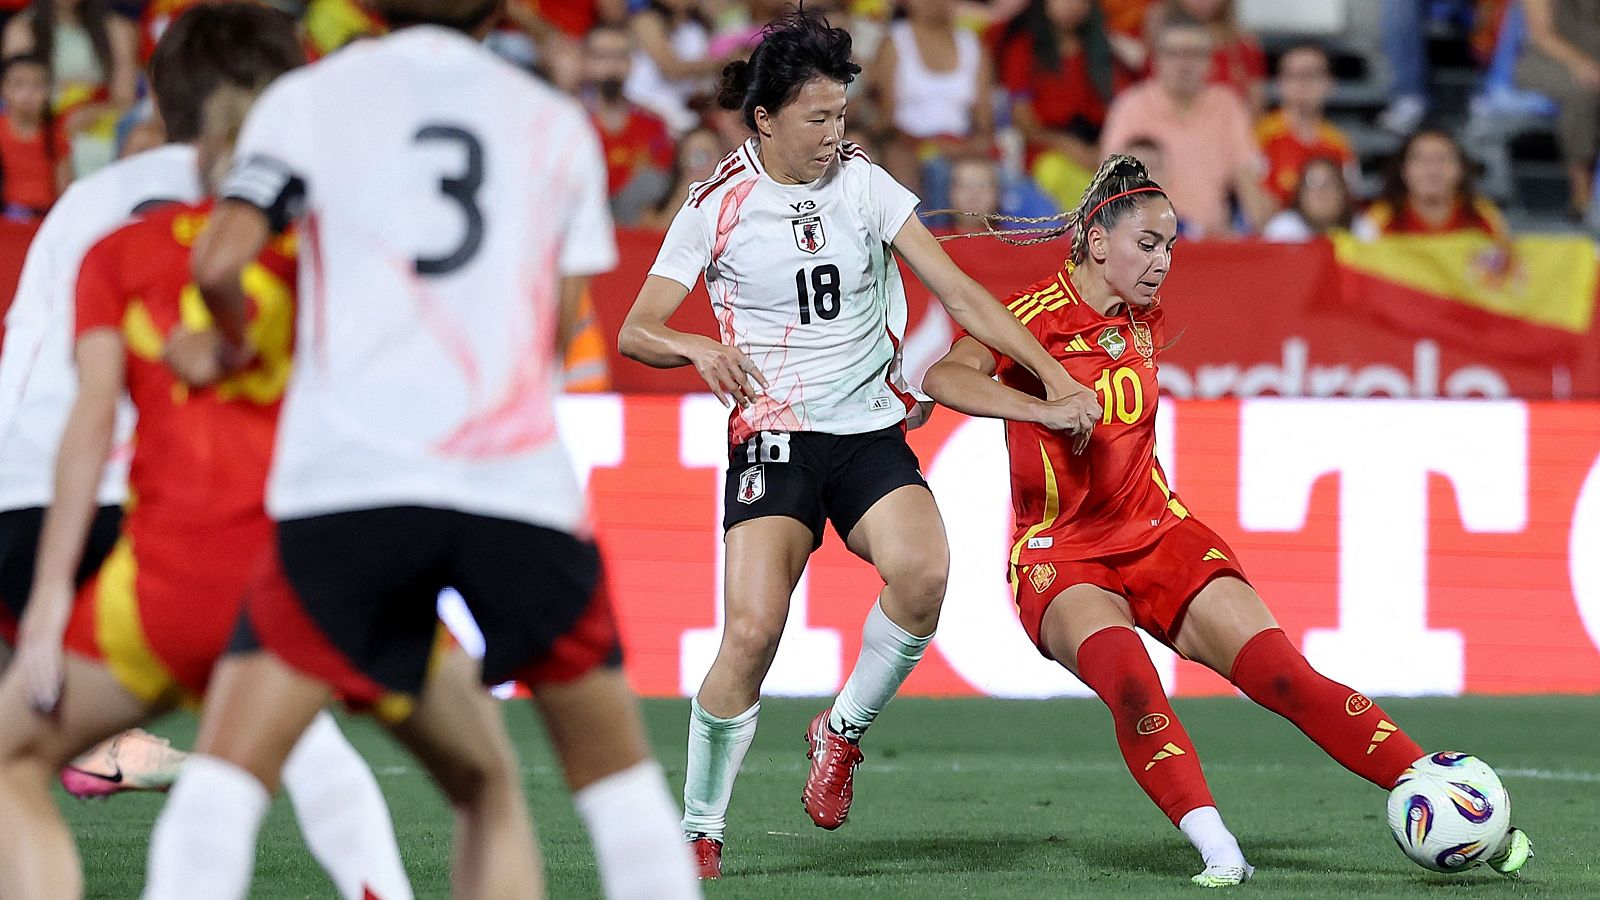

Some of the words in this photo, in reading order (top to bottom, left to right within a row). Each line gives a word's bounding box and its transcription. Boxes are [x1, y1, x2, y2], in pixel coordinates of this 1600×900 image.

[411, 121, 486, 277] 3
[789, 200, 816, 213] Y-3
[795, 263, 842, 325] 18
[1094, 366, 1144, 425] 10
